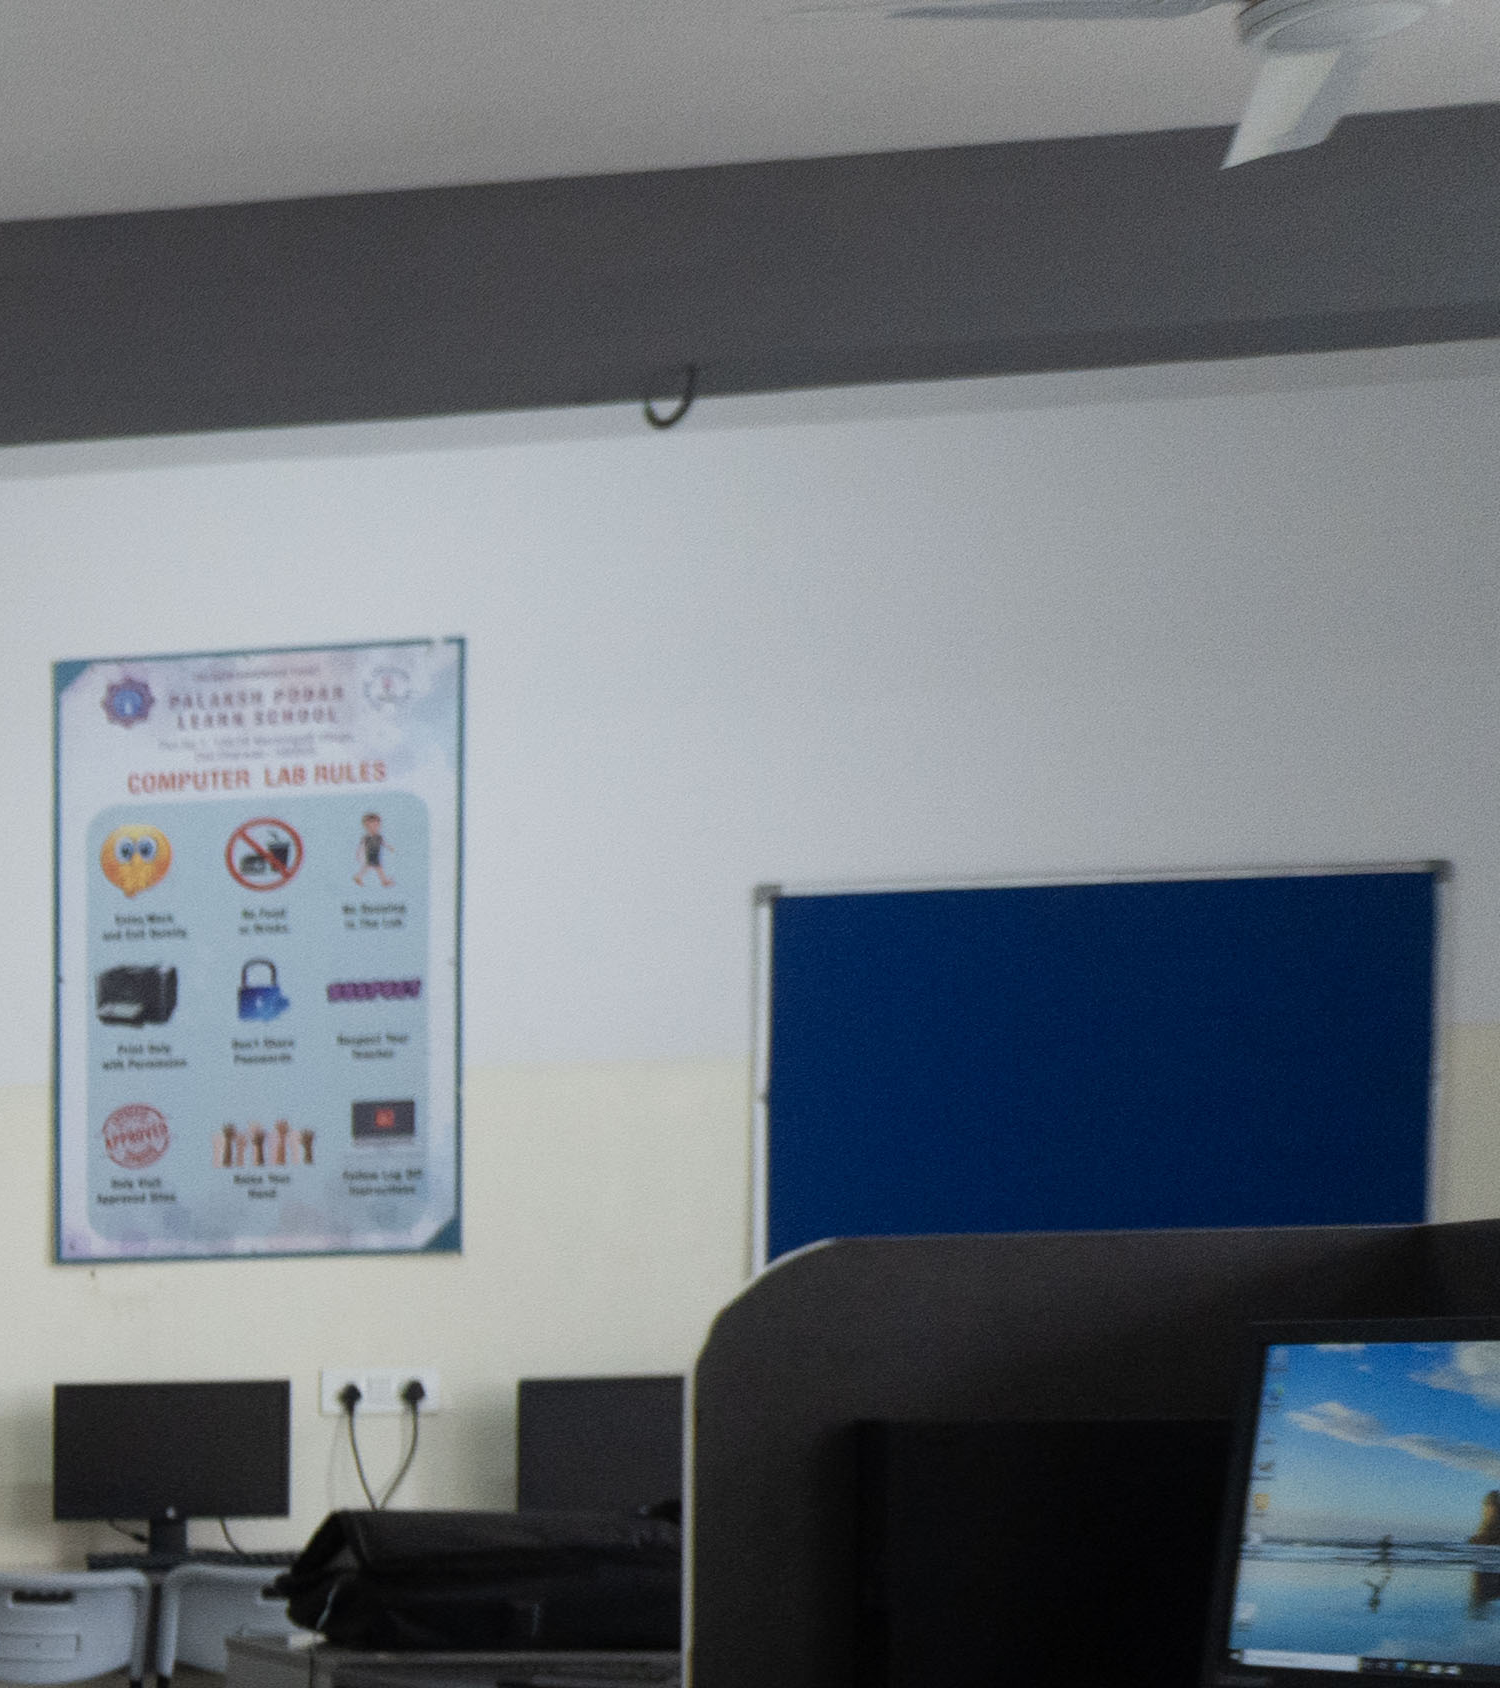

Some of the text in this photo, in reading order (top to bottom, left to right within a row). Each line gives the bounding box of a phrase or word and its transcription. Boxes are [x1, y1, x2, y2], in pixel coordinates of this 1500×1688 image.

[254, 706, 338, 726] SCHOOL
[127, 761, 387, 794] COMPUTER LAB RULES
